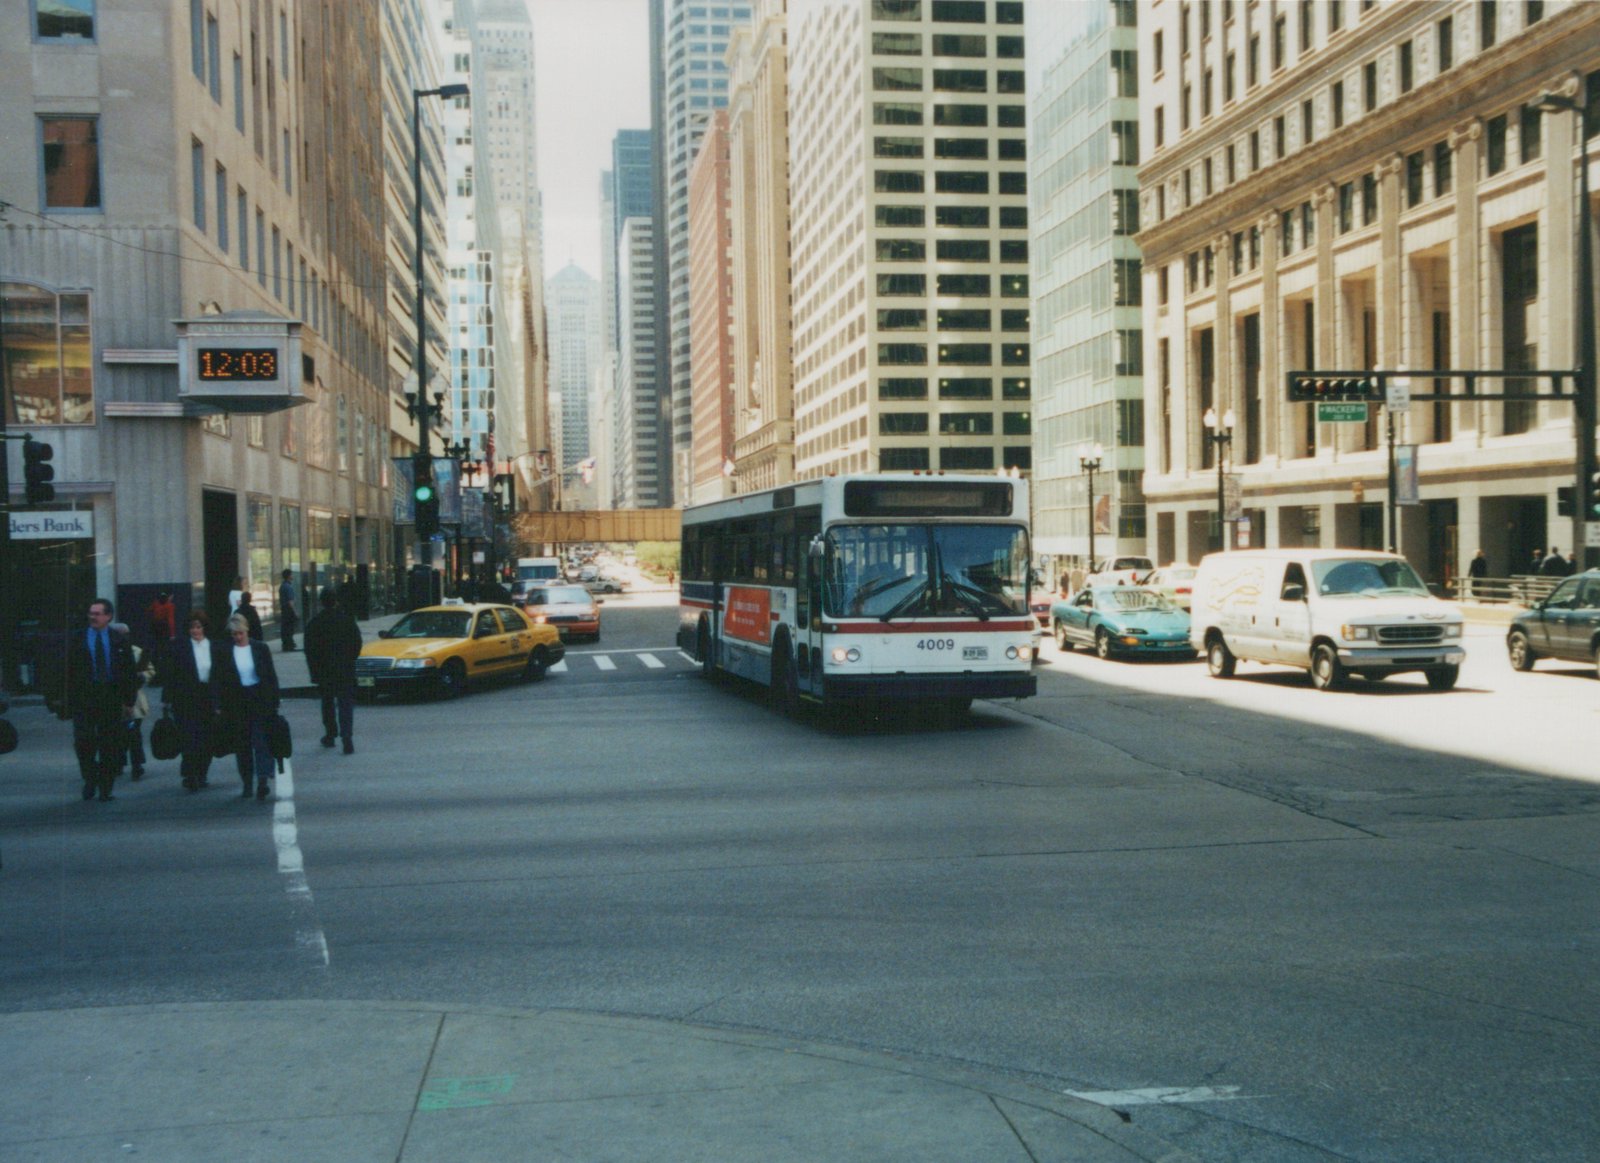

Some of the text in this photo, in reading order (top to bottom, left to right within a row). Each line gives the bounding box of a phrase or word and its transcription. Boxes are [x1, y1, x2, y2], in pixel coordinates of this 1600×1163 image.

[202, 352, 274, 376] 12:03
[1325, 405, 1356, 413] WACKER
[43, 518, 84, 532] Bank
[916, 638, 955, 651] 4009
